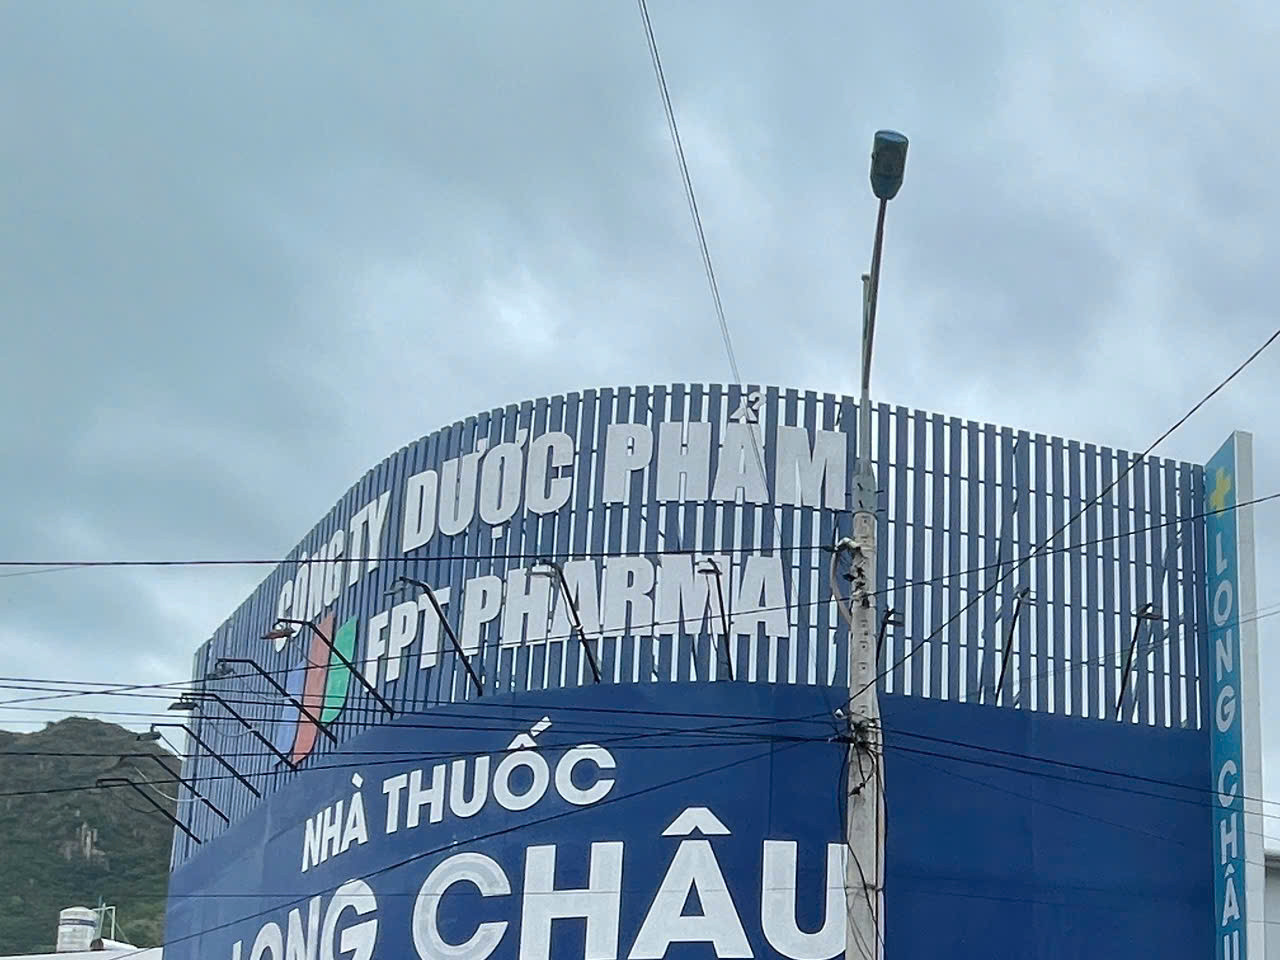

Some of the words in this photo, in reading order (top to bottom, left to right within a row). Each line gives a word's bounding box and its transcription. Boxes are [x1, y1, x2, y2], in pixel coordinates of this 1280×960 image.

[274, 529, 345, 653] CÔNG
[349, 490, 391, 587] TY
[402, 427, 574, 553] DƯỢC
[602, 392, 848, 511] PHẨM
[364, 587, 451, 692] FPT
[462, 554, 791, 657] PHARMA
[1214, 531, 1238, 734] LONG
[302, 773, 368, 874] NHÀ
[382, 716, 618, 834] THUỐC
